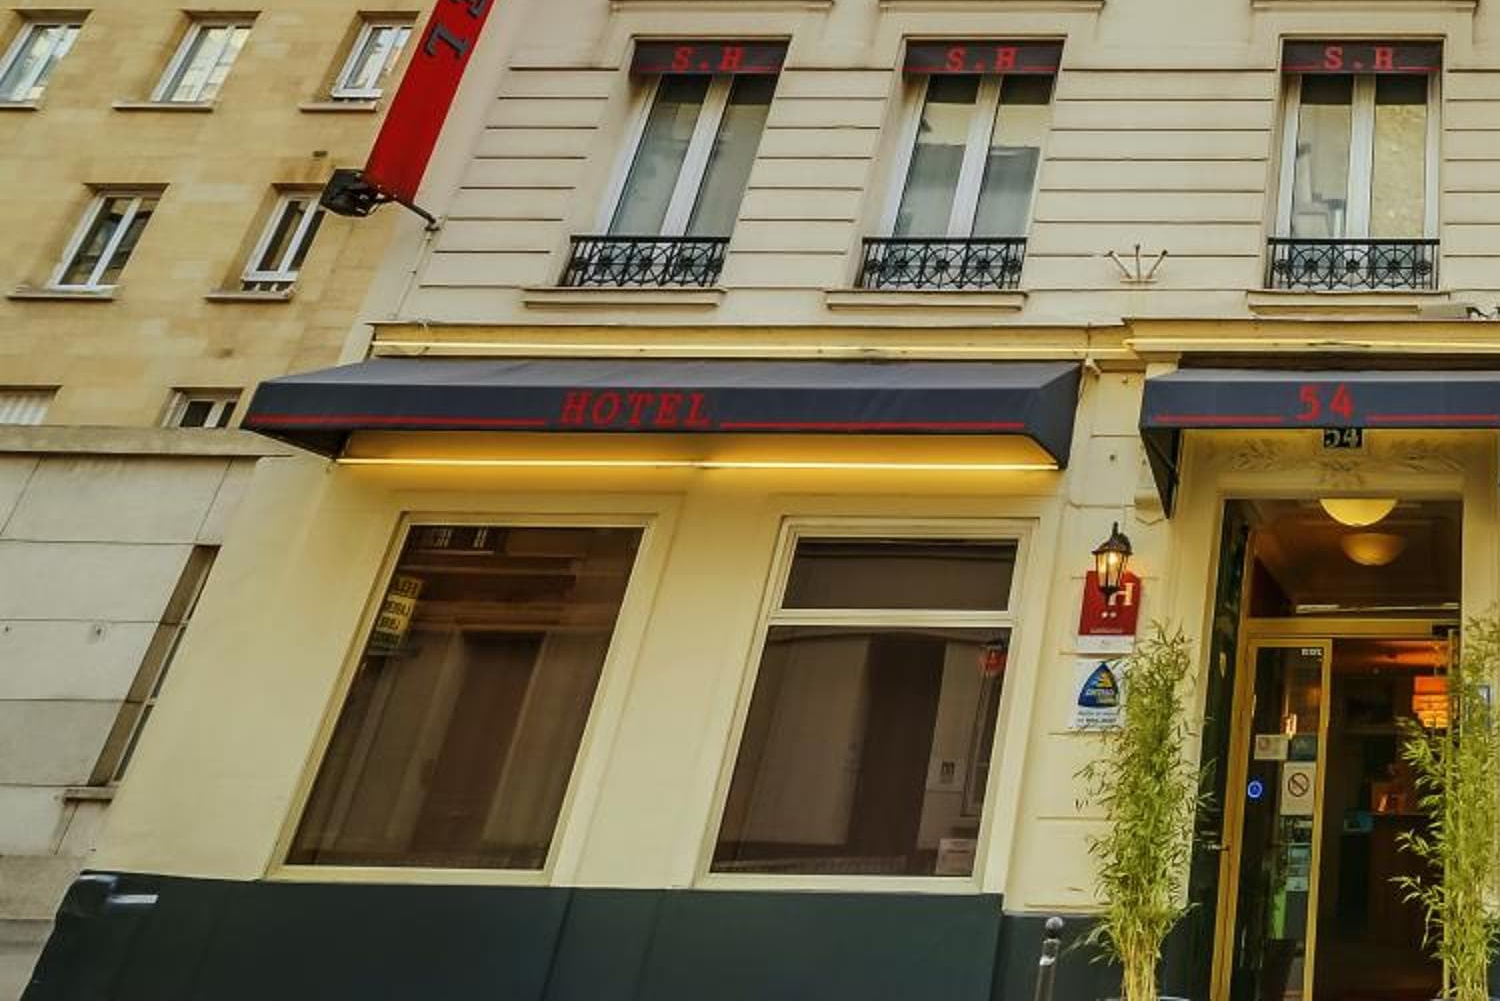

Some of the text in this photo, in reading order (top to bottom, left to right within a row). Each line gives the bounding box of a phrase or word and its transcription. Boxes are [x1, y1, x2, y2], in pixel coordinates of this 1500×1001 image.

[560, 389, 711, 427] HOTEL
[1295, 382, 1356, 422] 54
[1325, 426, 1359, 448] 54
